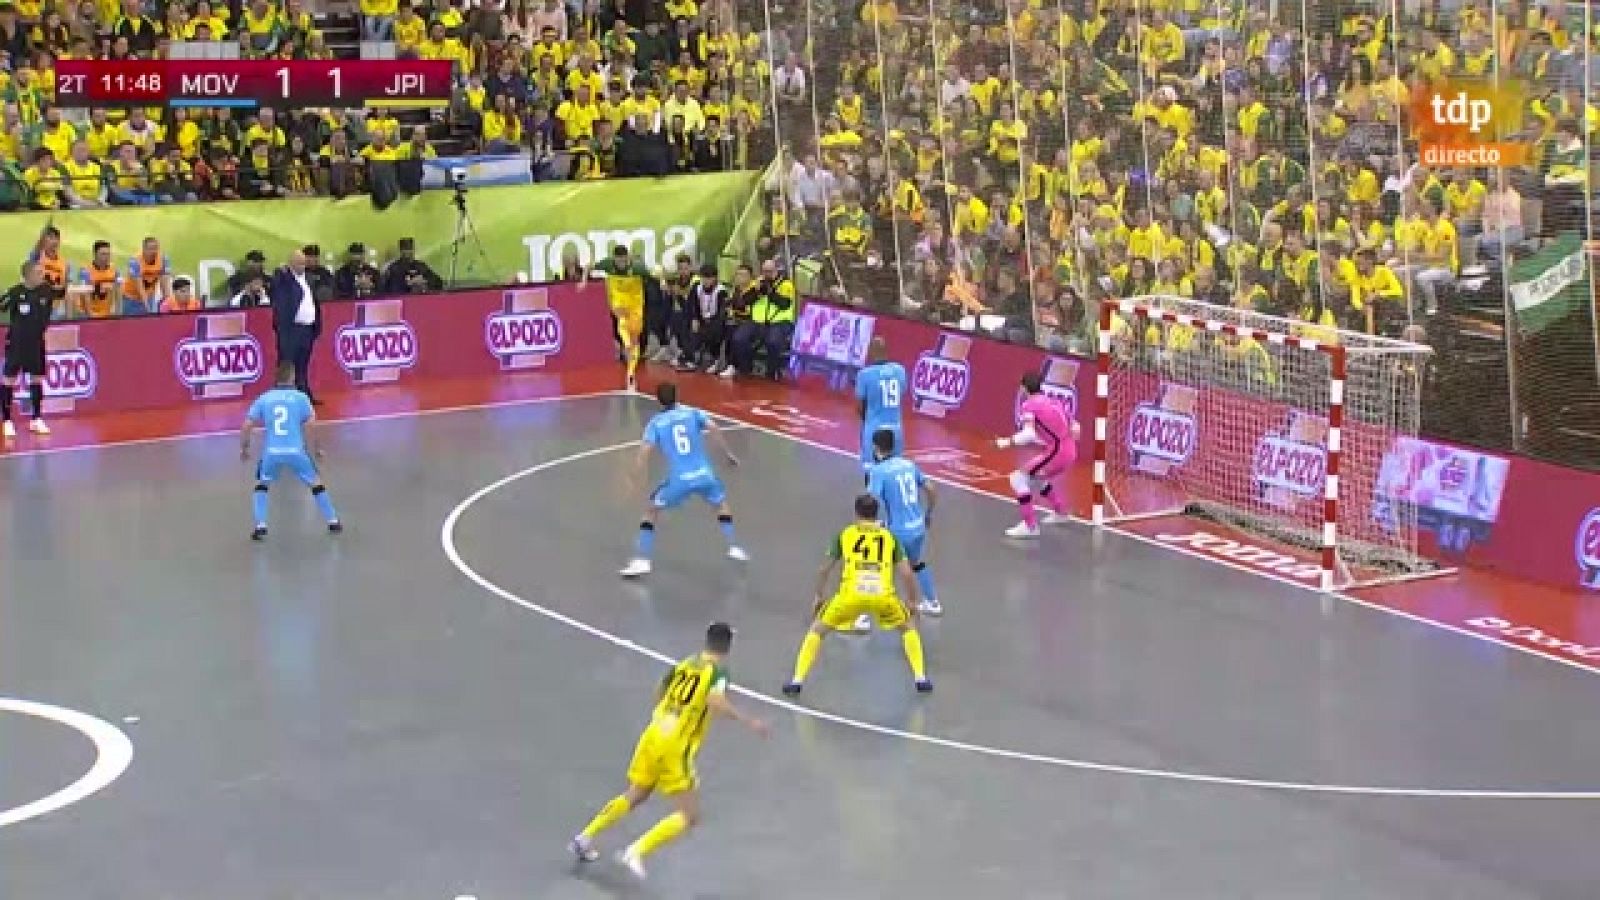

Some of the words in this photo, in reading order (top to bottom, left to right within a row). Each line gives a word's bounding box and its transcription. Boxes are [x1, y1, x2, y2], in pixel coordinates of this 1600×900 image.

[880, 379, 899, 408] 19
[273, 404, 289, 436] 2
[672, 424, 692, 455] 6
[852, 534, 885, 563] 41
